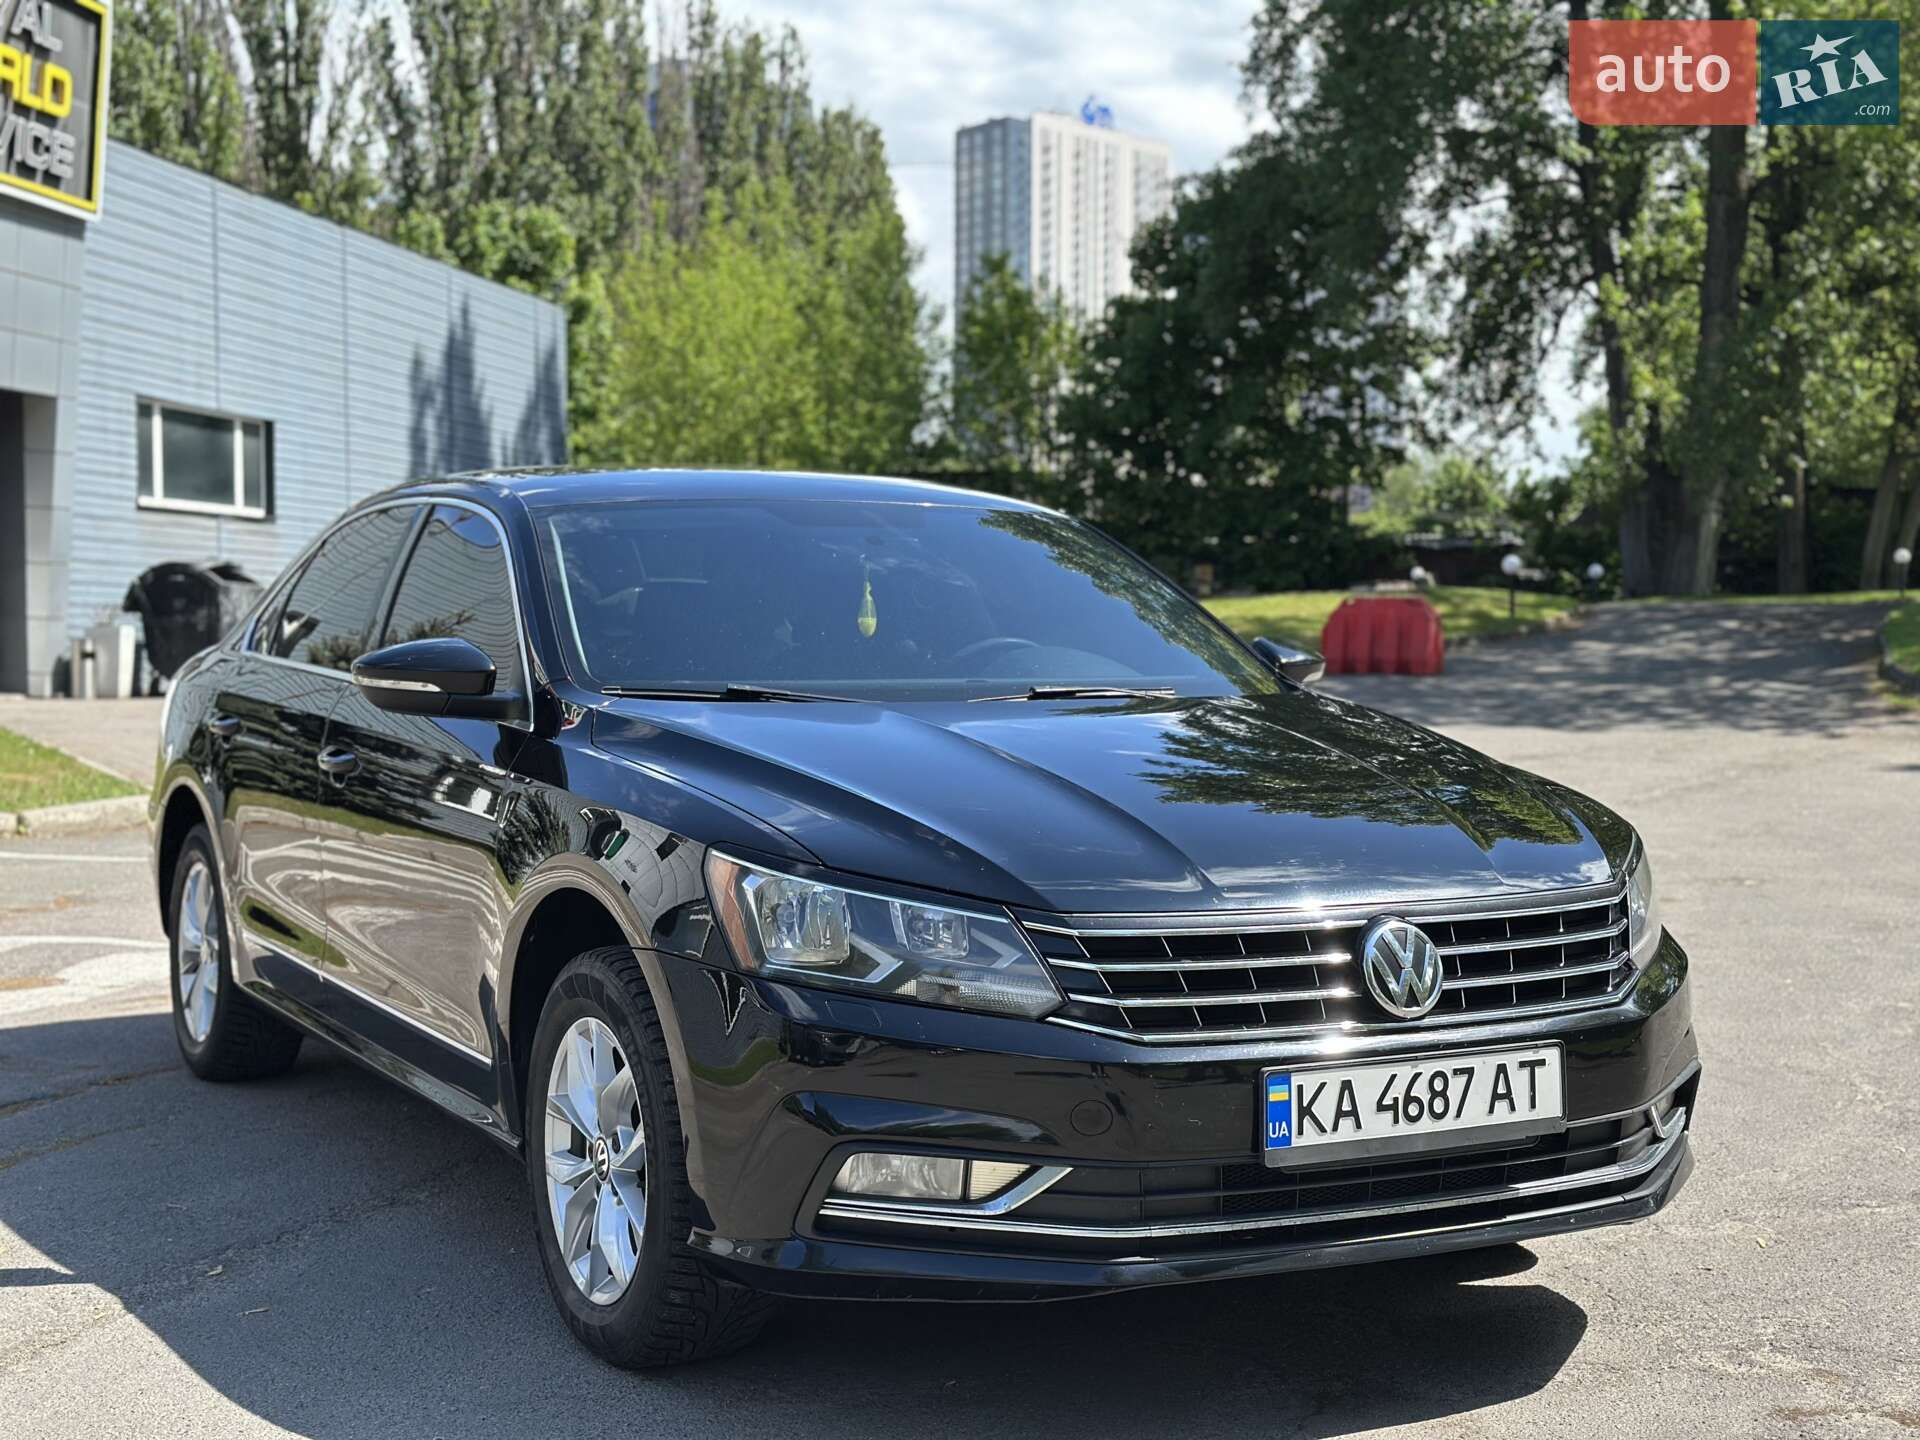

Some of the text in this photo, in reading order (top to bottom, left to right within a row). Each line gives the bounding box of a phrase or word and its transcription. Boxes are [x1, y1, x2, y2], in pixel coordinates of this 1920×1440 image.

[1296, 1058, 1548, 1137] KA 4687 AT
[1269, 1120, 1290, 1139] UA
